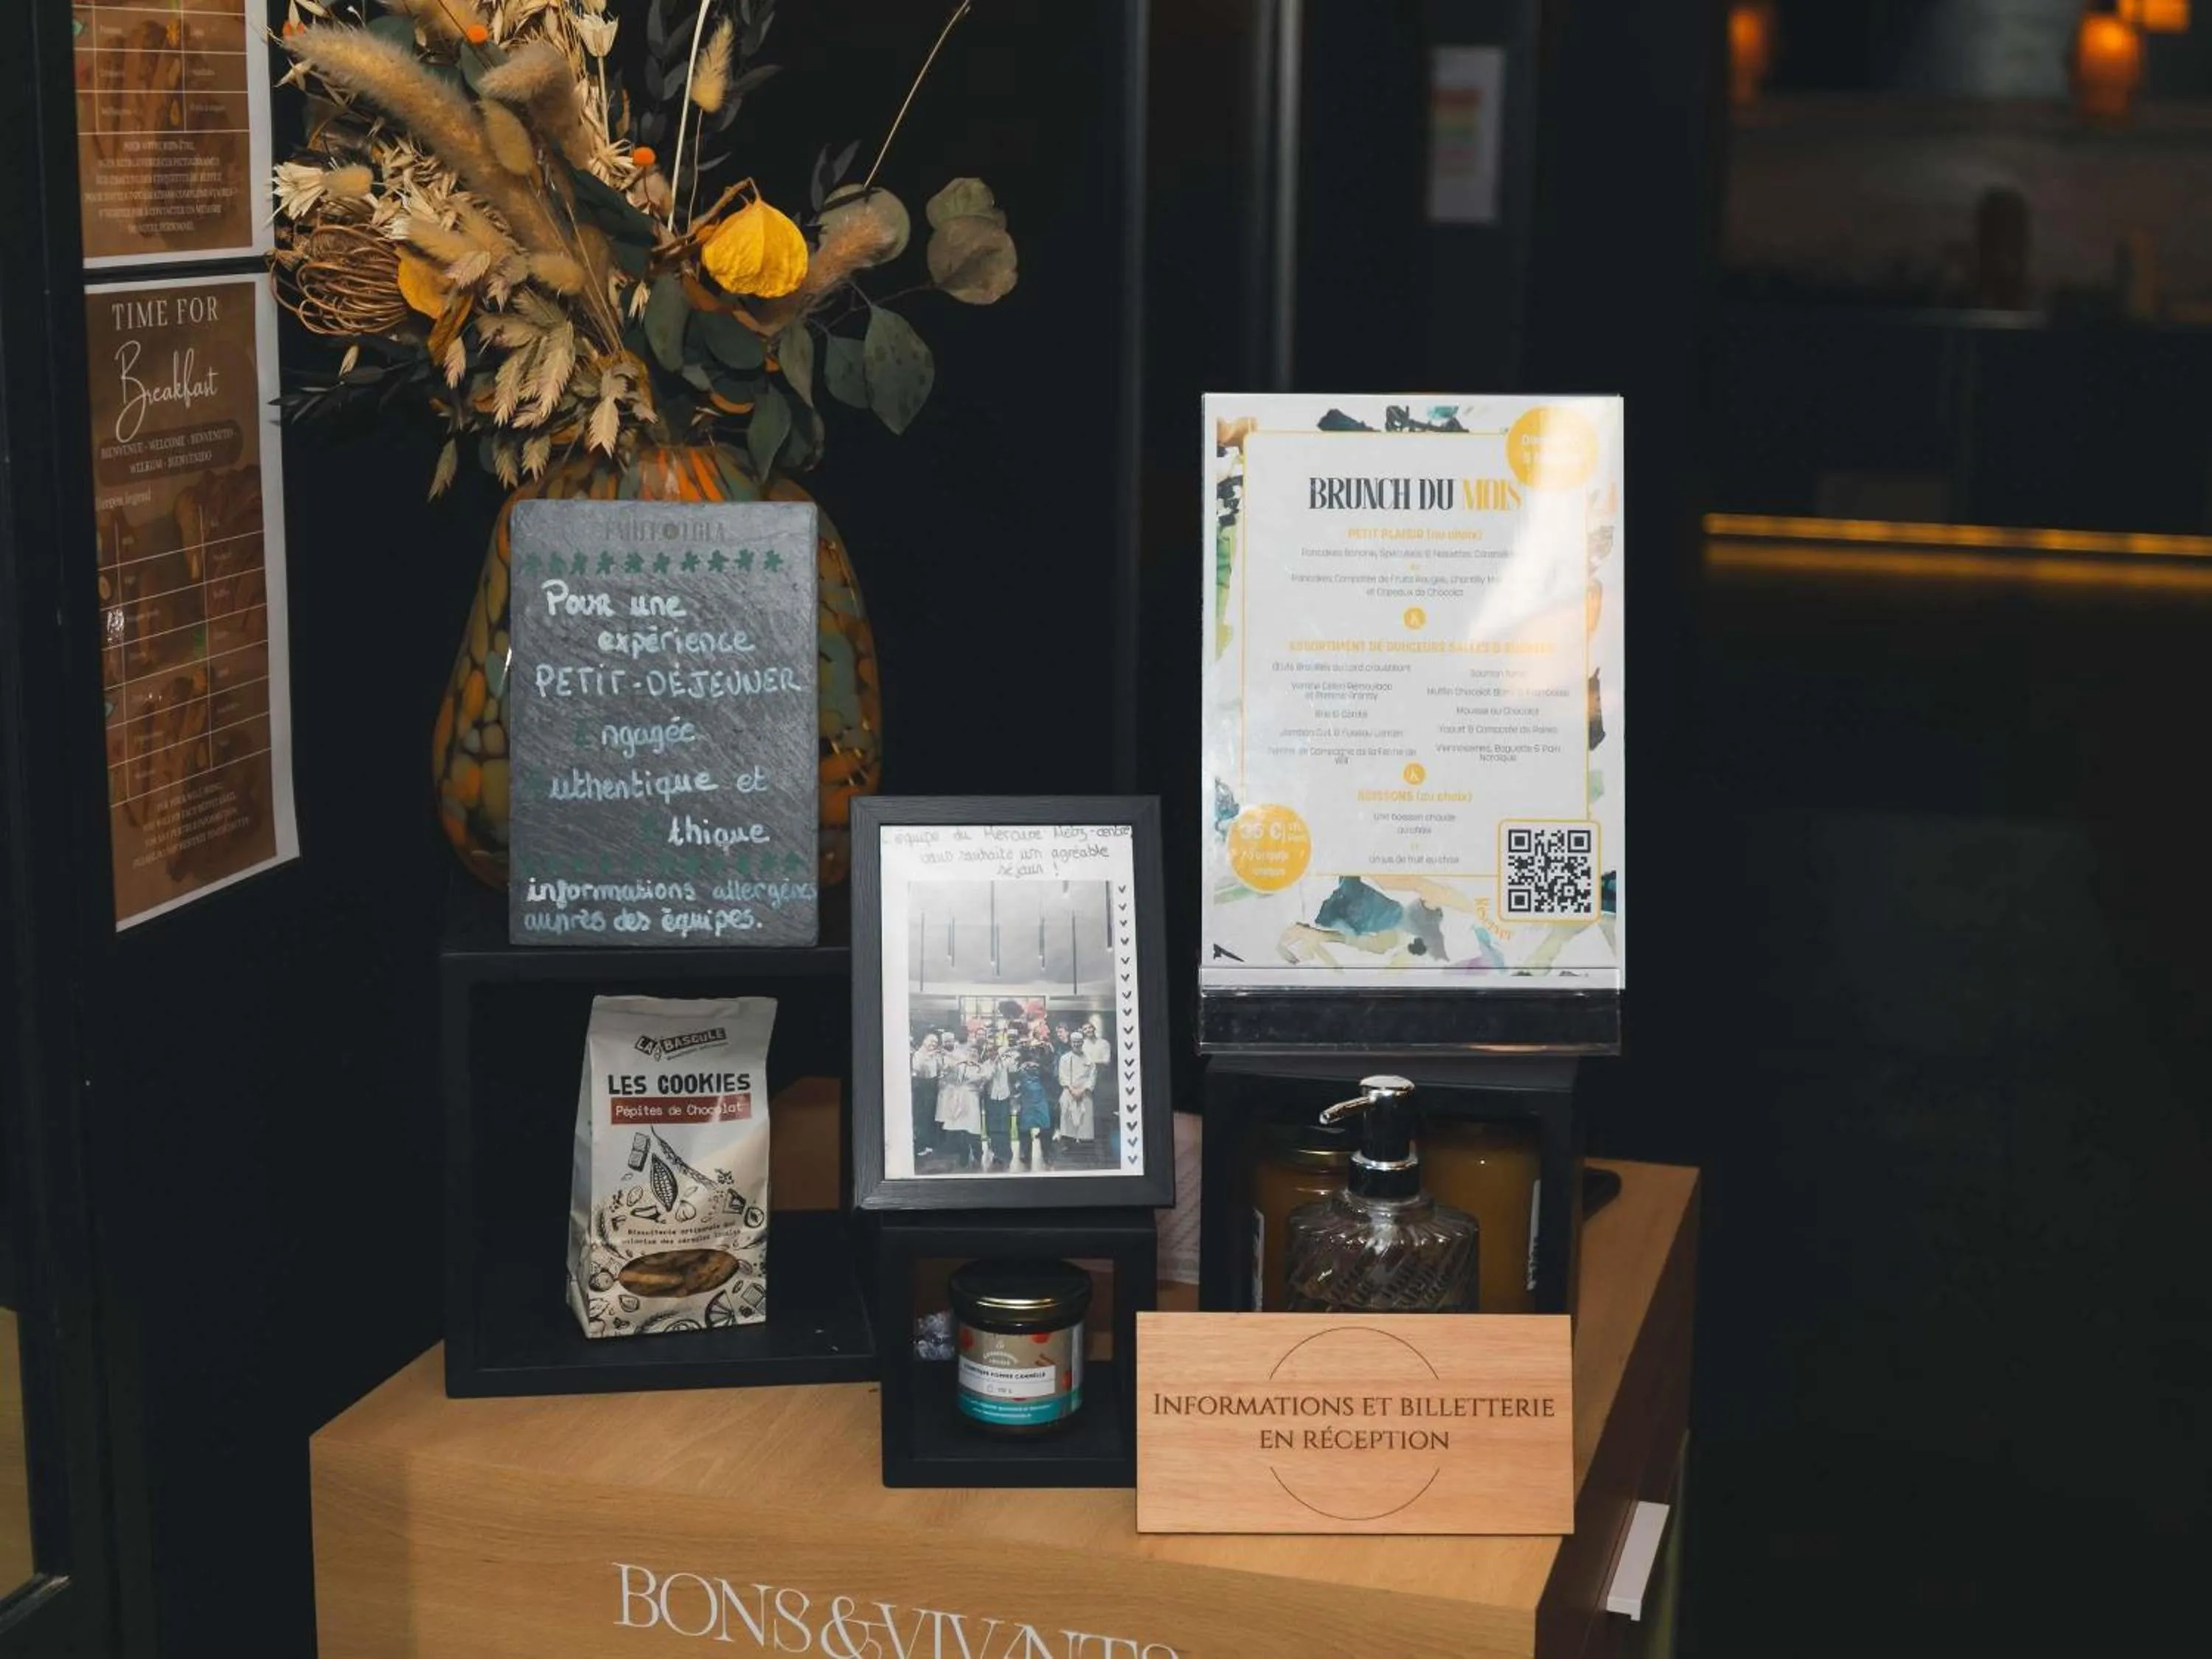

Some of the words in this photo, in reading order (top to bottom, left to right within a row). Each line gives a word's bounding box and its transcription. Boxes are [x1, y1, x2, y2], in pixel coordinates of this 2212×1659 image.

[111, 299, 169, 331] TIME
[177, 296, 220, 325] FOR
[114, 340, 220, 443] Breakfast
[1308, 477, 1411, 510] BRUNCH
[1419, 478, 1455, 511] DU
[1462, 478, 1523, 512] MOIS
[540, 580, 615, 616] Pour
[629, 593, 686, 617] une
[598, 626, 755, 659] expérience
[737, 765, 768, 793] et
[526, 877, 698, 908] informations
[613, 908, 650, 933] des
[635, 1034, 654, 1056] LA
[660, 1027, 727, 1054] BASCULE
[608, 1074, 647, 1096] LES
[657, 1073, 751, 1094] COOKIES
[668, 1106, 682, 1116] de
[686, 1103, 744, 1116] Chocolat
[1153, 1393, 1354, 1418] INFORMATIONS
[1363, 1397, 1393, 1417] ET
[1400, 1397, 1556, 1418] BILLETTERIE
[1259, 1429, 1294, 1450] EN
[1303, 1425, 1450, 1451] RÉCEPTION
